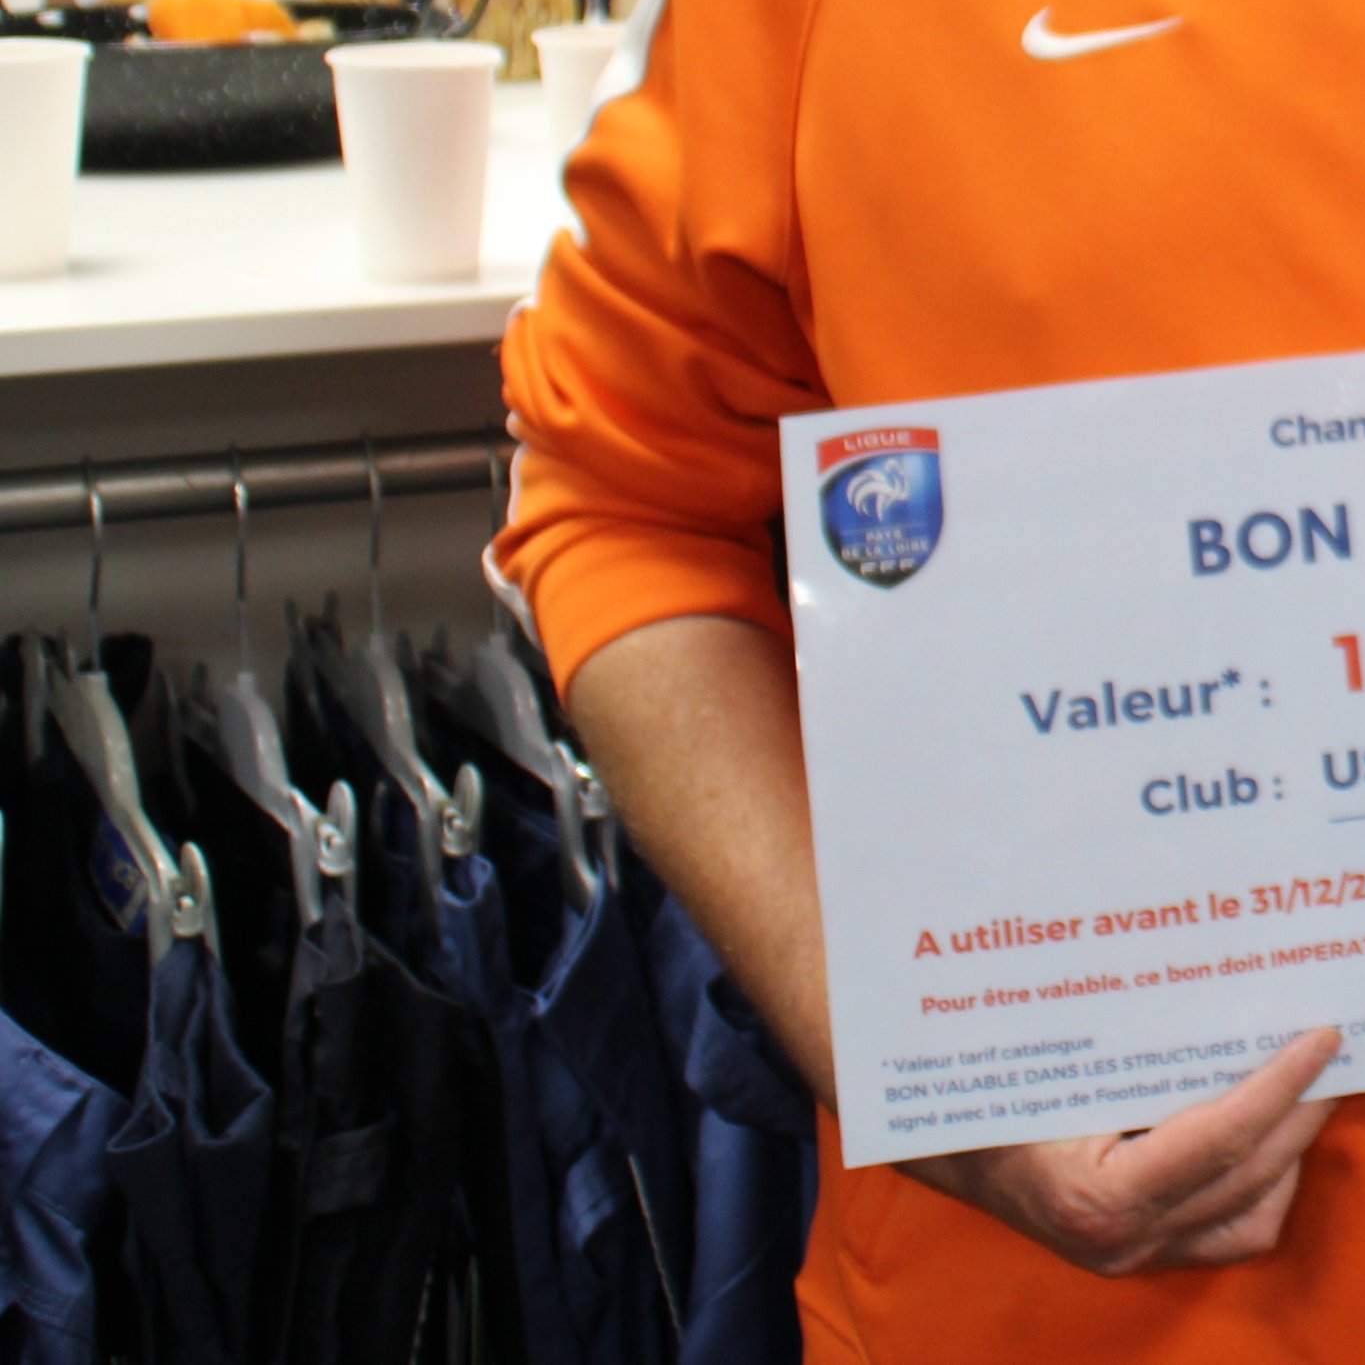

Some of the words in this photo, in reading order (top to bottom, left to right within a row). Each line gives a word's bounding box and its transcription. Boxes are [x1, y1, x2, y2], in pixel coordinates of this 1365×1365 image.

[843, 431, 912, 452] LIGUE
[1186, 501, 1352, 578] BON
[1139, 765, 1260, 818] Club
[913, 927, 942, 960] A
[949, 914, 1084, 955] utiliser
[1092, 896, 1199, 937] avant
[1207, 890, 1242, 922] le
[919, 992, 977, 1016] Pour
[981, 986, 1032, 1009] être
[1035, 971, 1127, 1001] valable,
[1133, 968, 1162, 989] ce
[1164, 961, 1213, 984] bon
[1216, 951, 1265, 977] doit
[883, 1082, 929, 1105] BON
[931, 1069, 1019, 1098] VALABLE
[1022, 1061, 1080, 1087] DANS
[1082, 1056, 1119, 1079] LES
[1120, 1037, 1248, 1073] STRUCTURES
[1255, 1029, 1306, 1054] CLU
[891, 1053, 953, 1075] Valeur
[956, 1043, 997, 1068] tarif
[998, 1035, 1095, 1063] catalogue
[886, 1110, 938, 1136] signé
[941, 1106, 984, 1127] avec
[988, 1101, 1007, 1120] la
[1009, 1095, 1063, 1119] Ligue
[1064, 1090, 1091, 1110] de
[1093, 1076, 1172, 1105] Football
[1174, 1074, 1209, 1094] des
